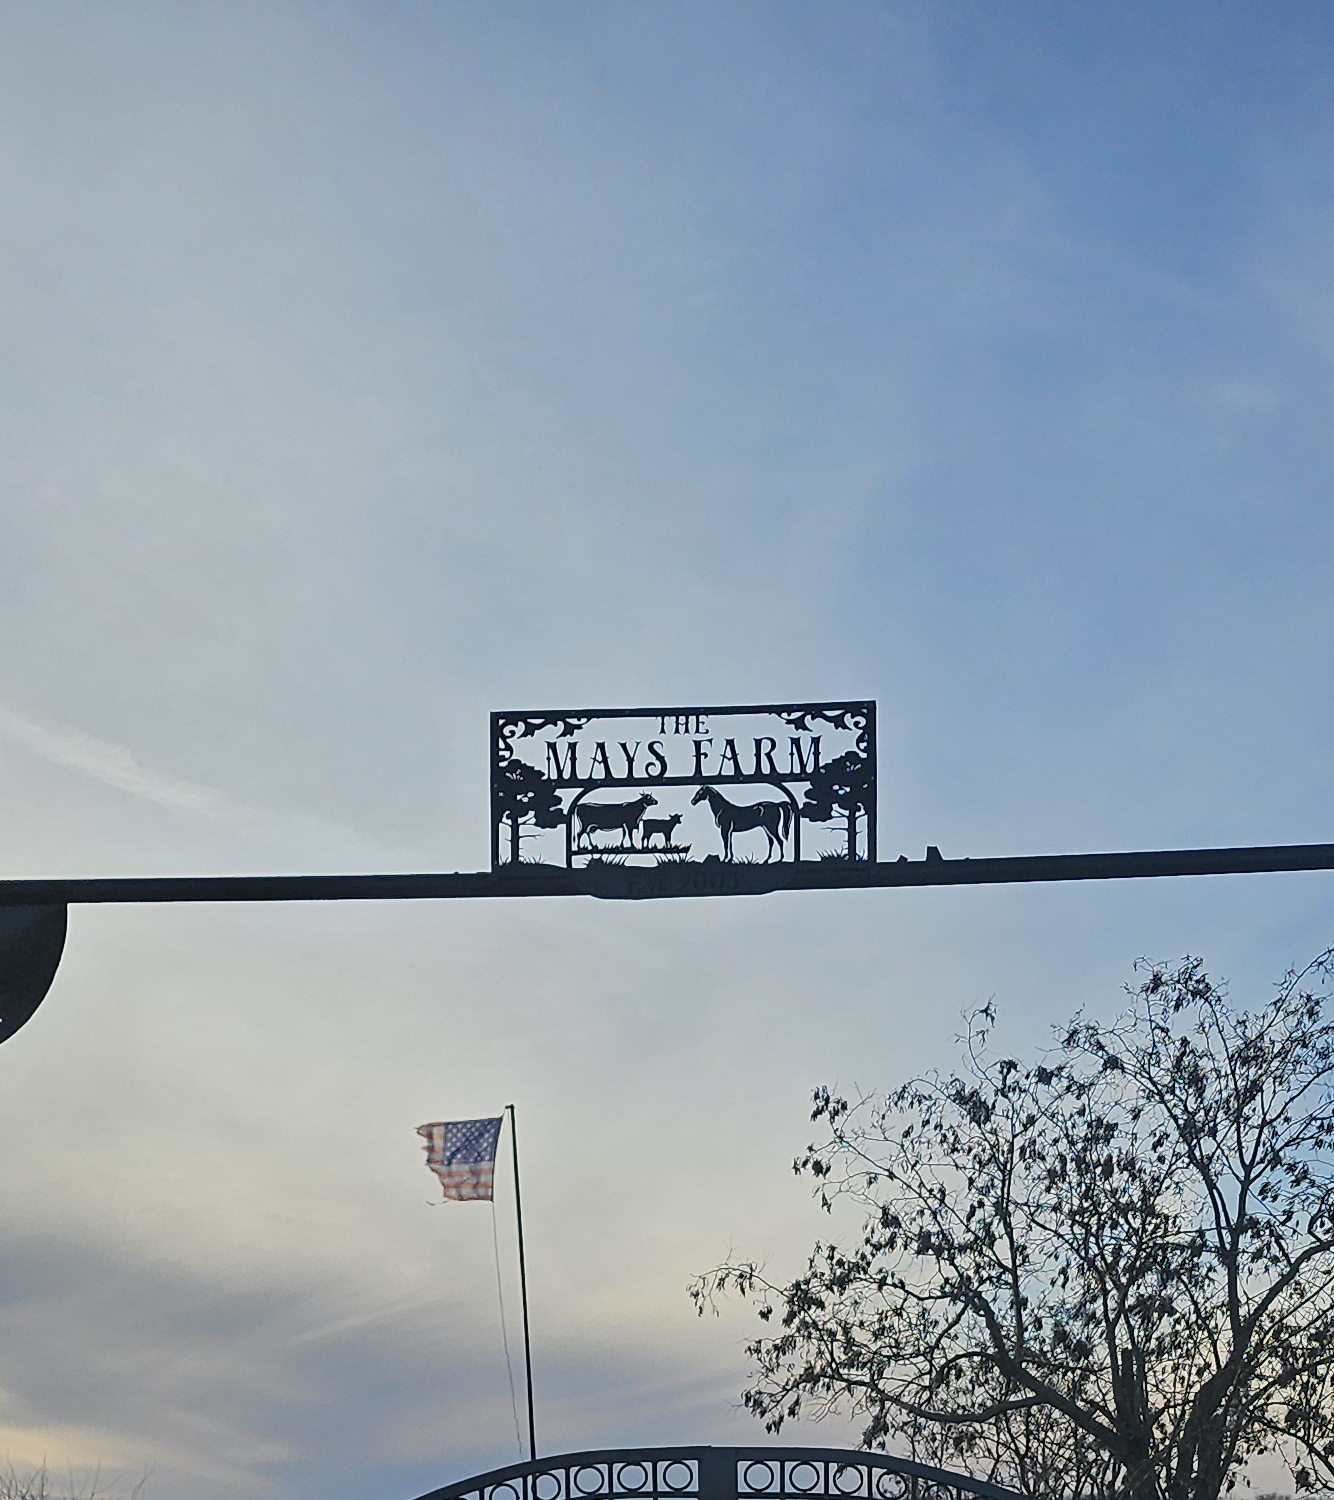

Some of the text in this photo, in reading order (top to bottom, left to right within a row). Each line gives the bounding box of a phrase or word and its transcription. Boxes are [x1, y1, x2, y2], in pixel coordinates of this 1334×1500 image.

[655, 714, 709, 735] THE
[544, 735, 823, 780] MAYS FARM
